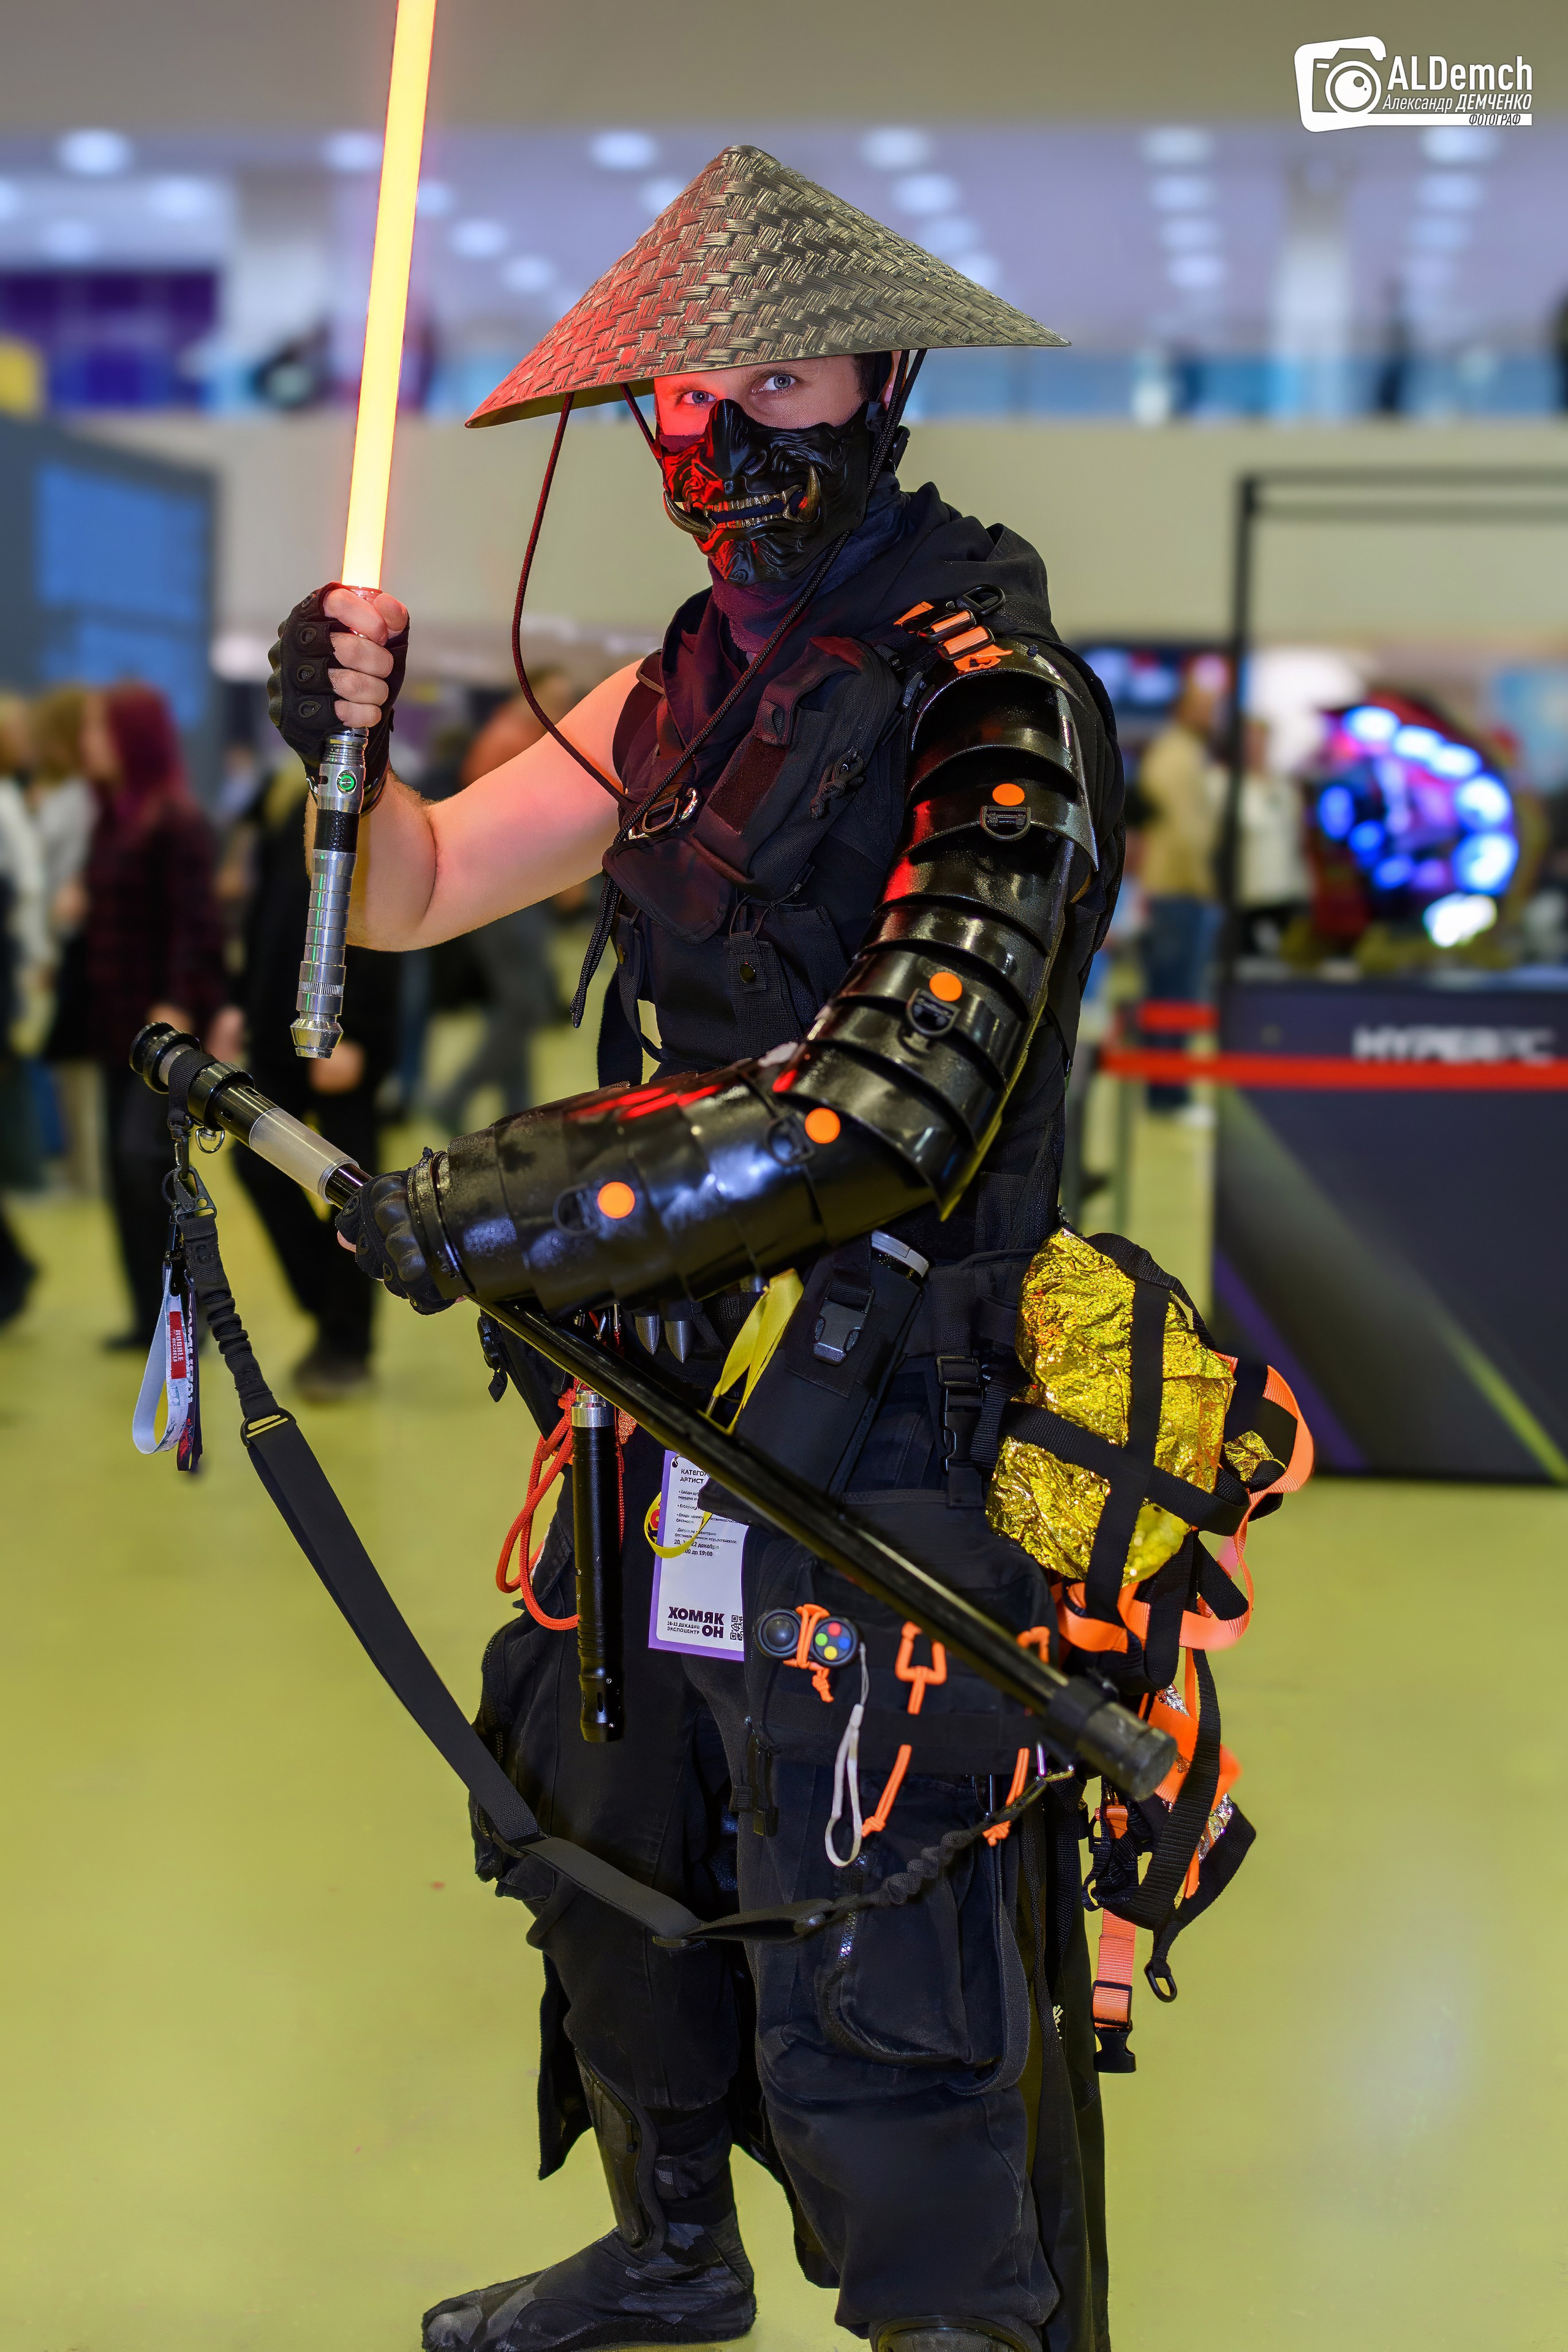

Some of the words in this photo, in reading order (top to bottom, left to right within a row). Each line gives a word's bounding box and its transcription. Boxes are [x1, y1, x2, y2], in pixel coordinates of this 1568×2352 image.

[668, 1606, 725, 1626] ХОМЯК
[666, 1626, 700, 1635] ЭКСПОЦЕНТР
[702, 1624, 724, 1638] ОН
